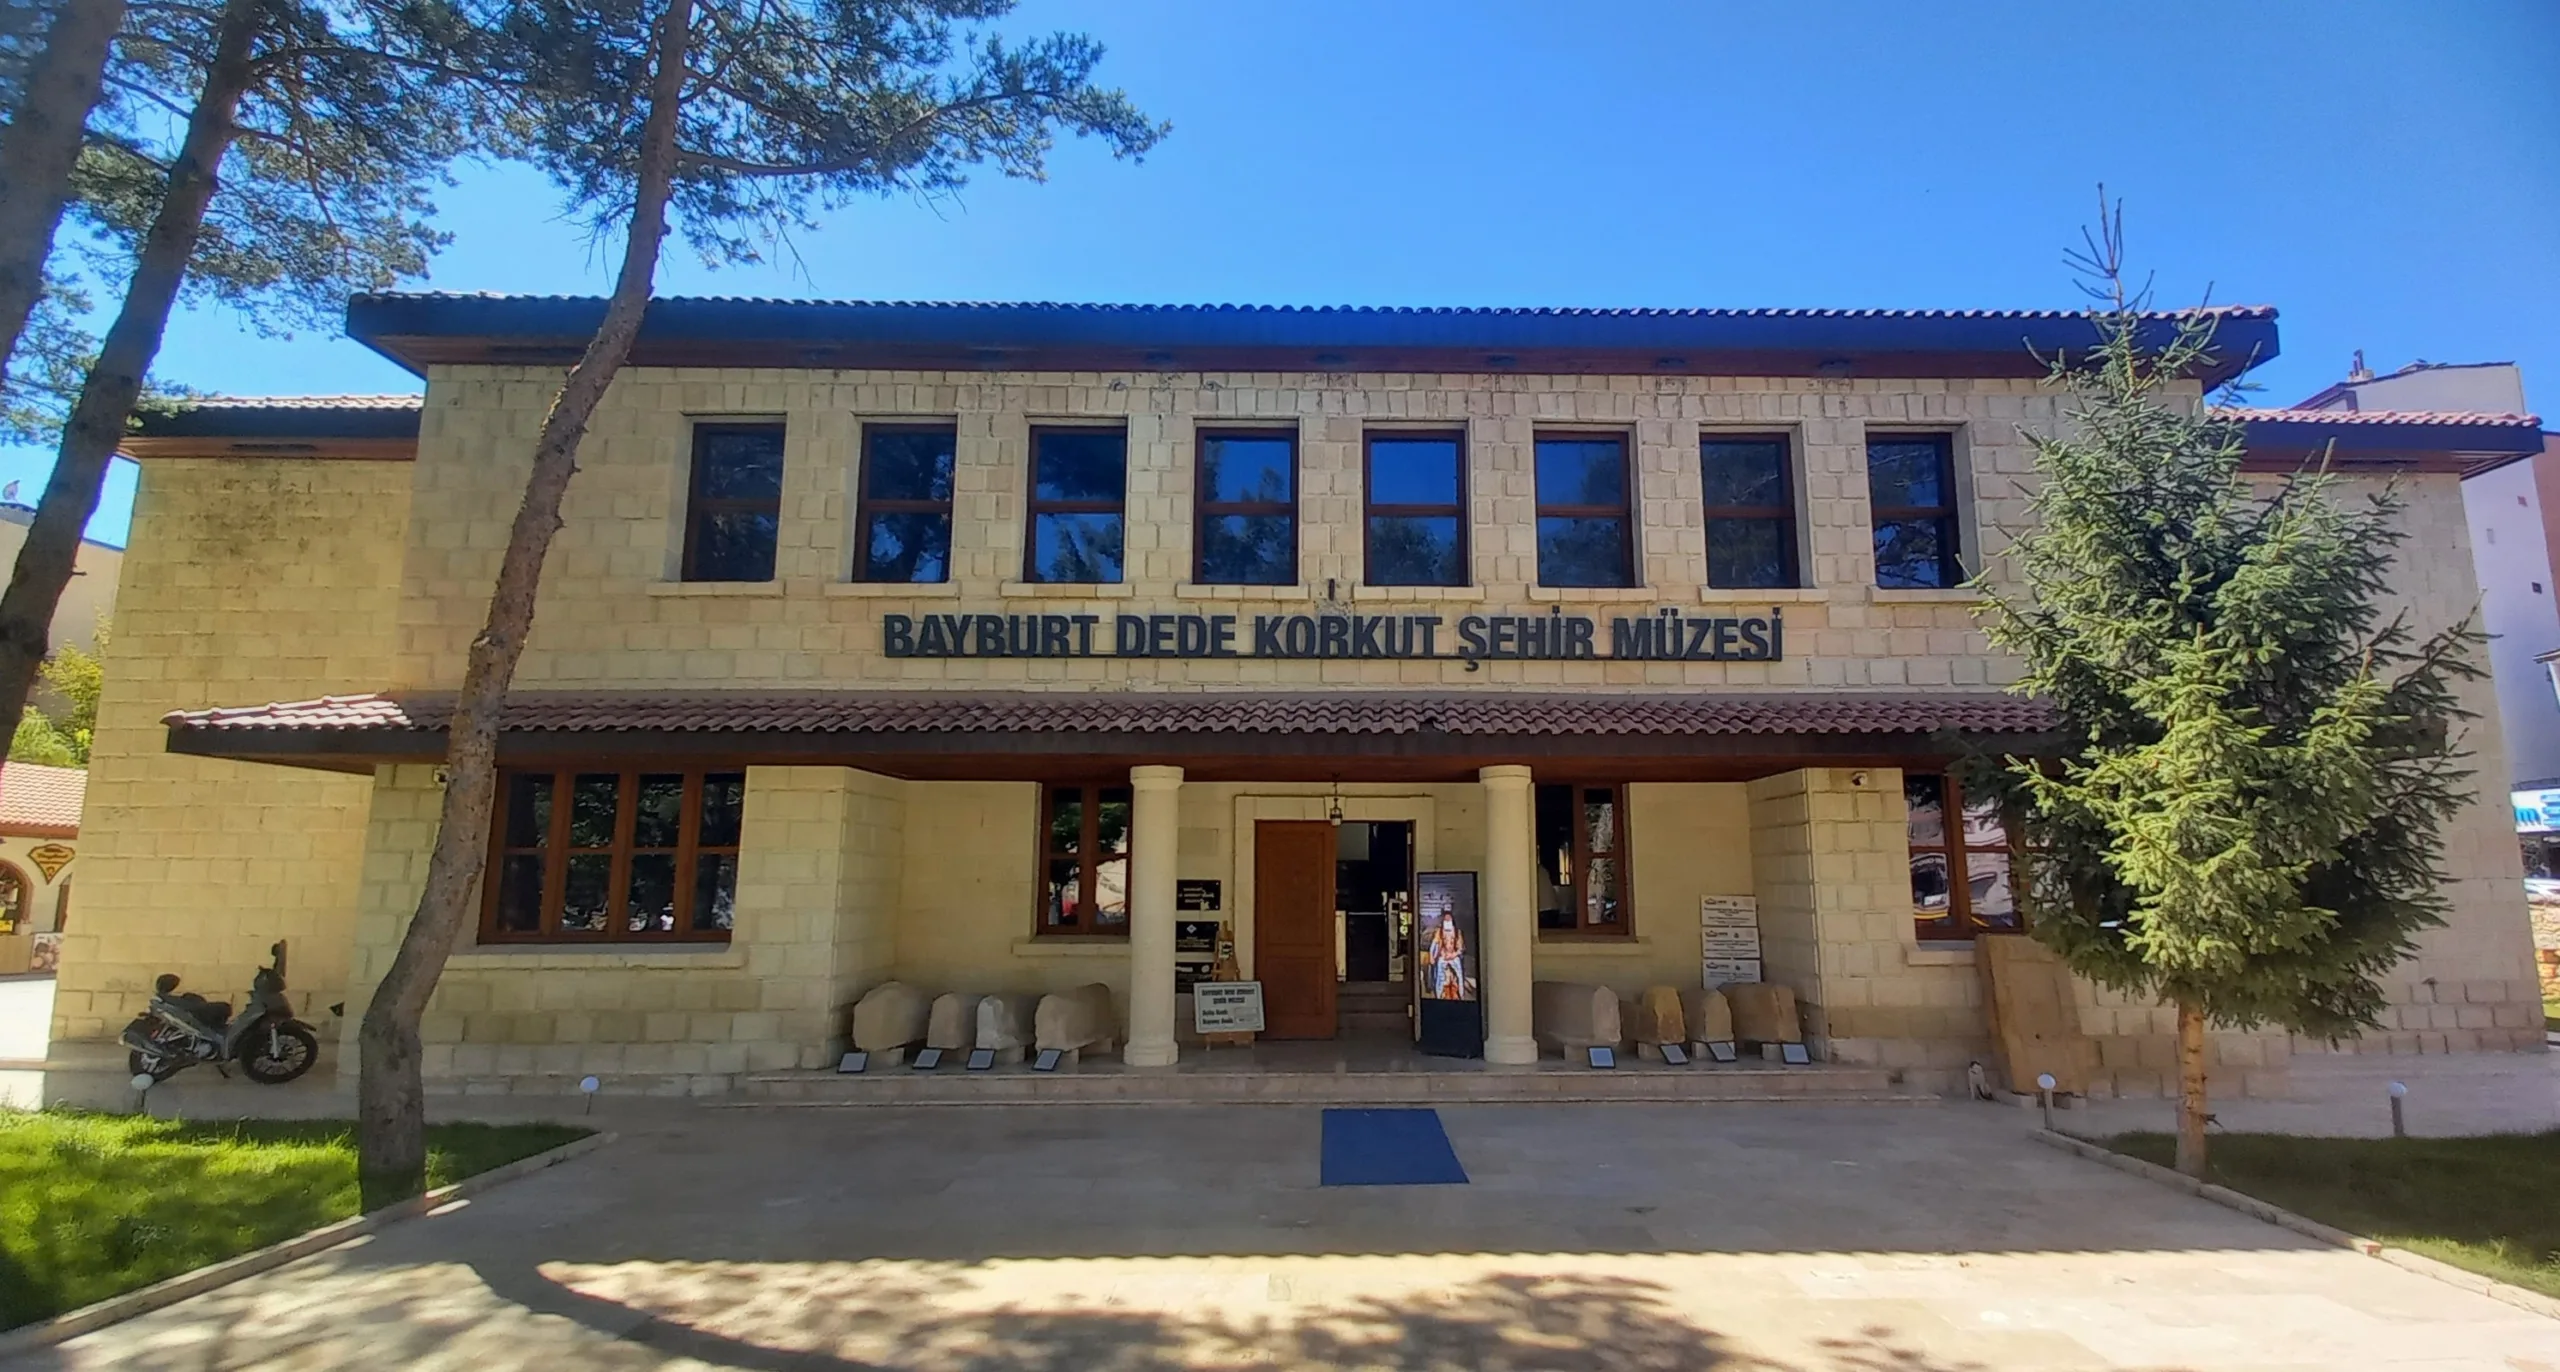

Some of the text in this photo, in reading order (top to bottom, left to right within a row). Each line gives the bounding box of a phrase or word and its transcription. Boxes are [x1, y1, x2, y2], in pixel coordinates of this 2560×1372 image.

[884, 605, 1781, 671] BAYBURT DEDE KORKUT ŞEHİR MÜZESİ
